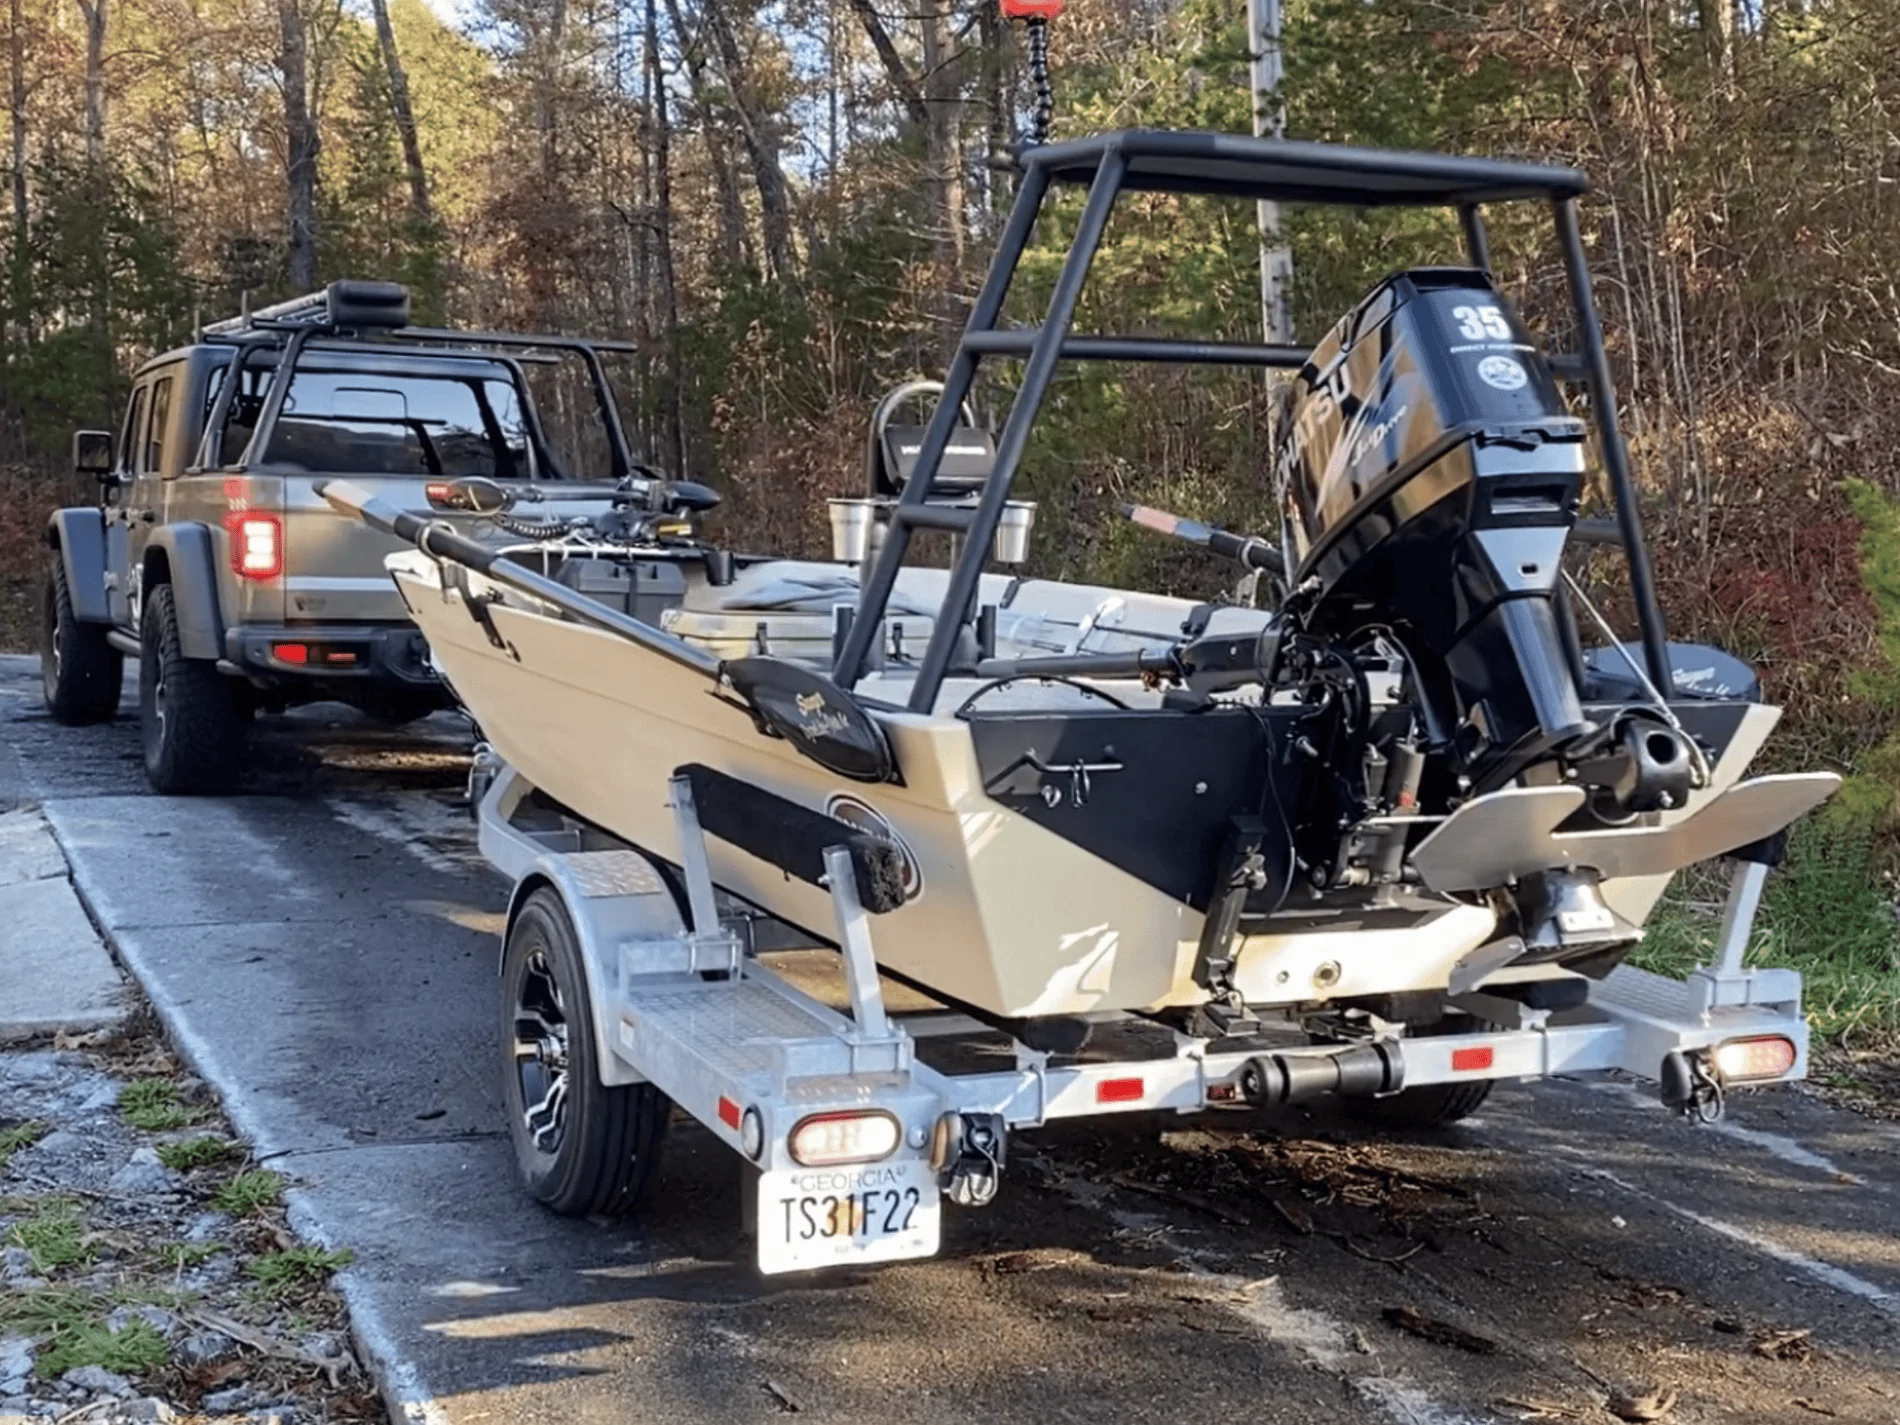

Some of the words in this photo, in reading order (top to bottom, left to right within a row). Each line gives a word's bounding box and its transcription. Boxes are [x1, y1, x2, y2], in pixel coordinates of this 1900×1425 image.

[1453, 306, 1513, 340] 35
[1273, 363, 1352, 495] OHATSU
[799, 1168, 897, 1192] GEORGIA
[779, 1187, 920, 1243] TS31F22
